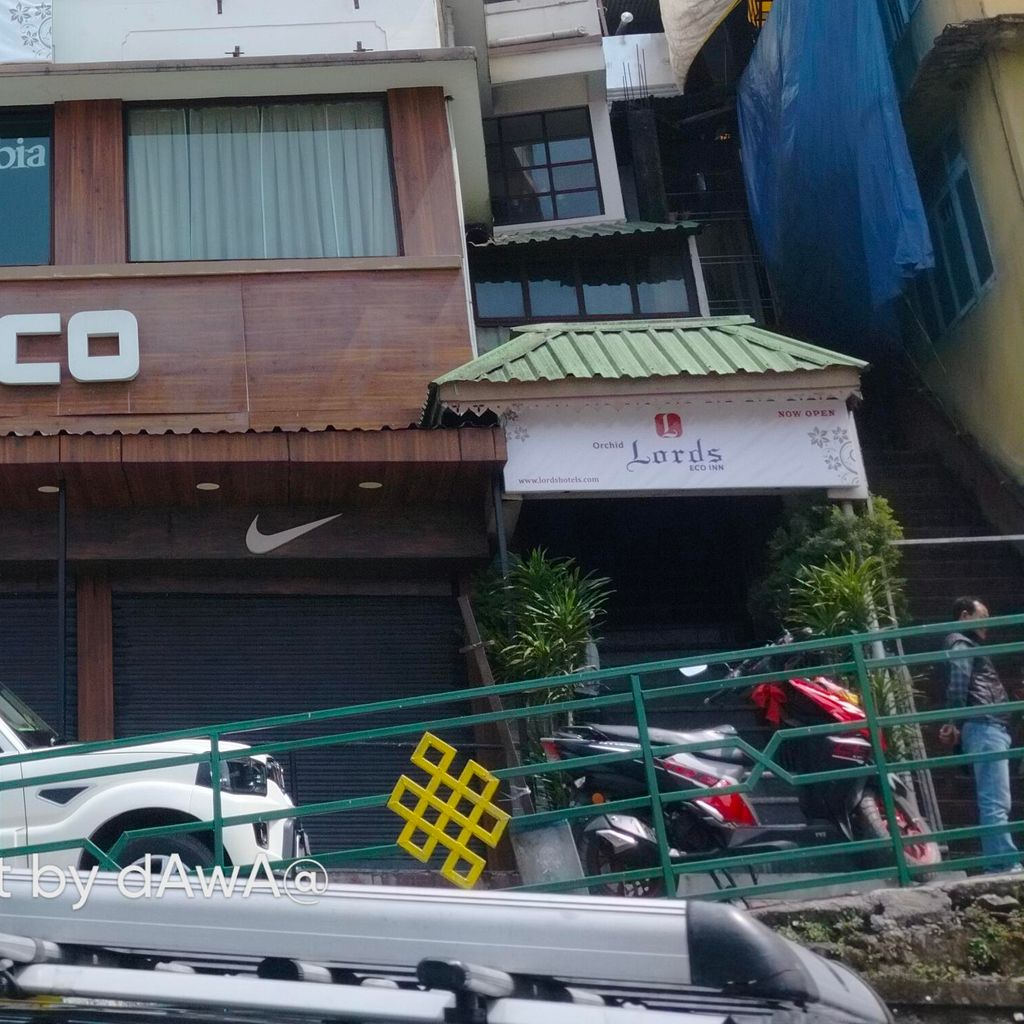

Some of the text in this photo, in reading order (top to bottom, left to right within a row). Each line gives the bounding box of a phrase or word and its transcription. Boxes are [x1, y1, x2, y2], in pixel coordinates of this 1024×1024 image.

[777, 409, 836, 418] NOW OPEN
[592, 439, 723, 472] Orchid Lords
[518, 475, 600, 485] www.lordshotels.com
